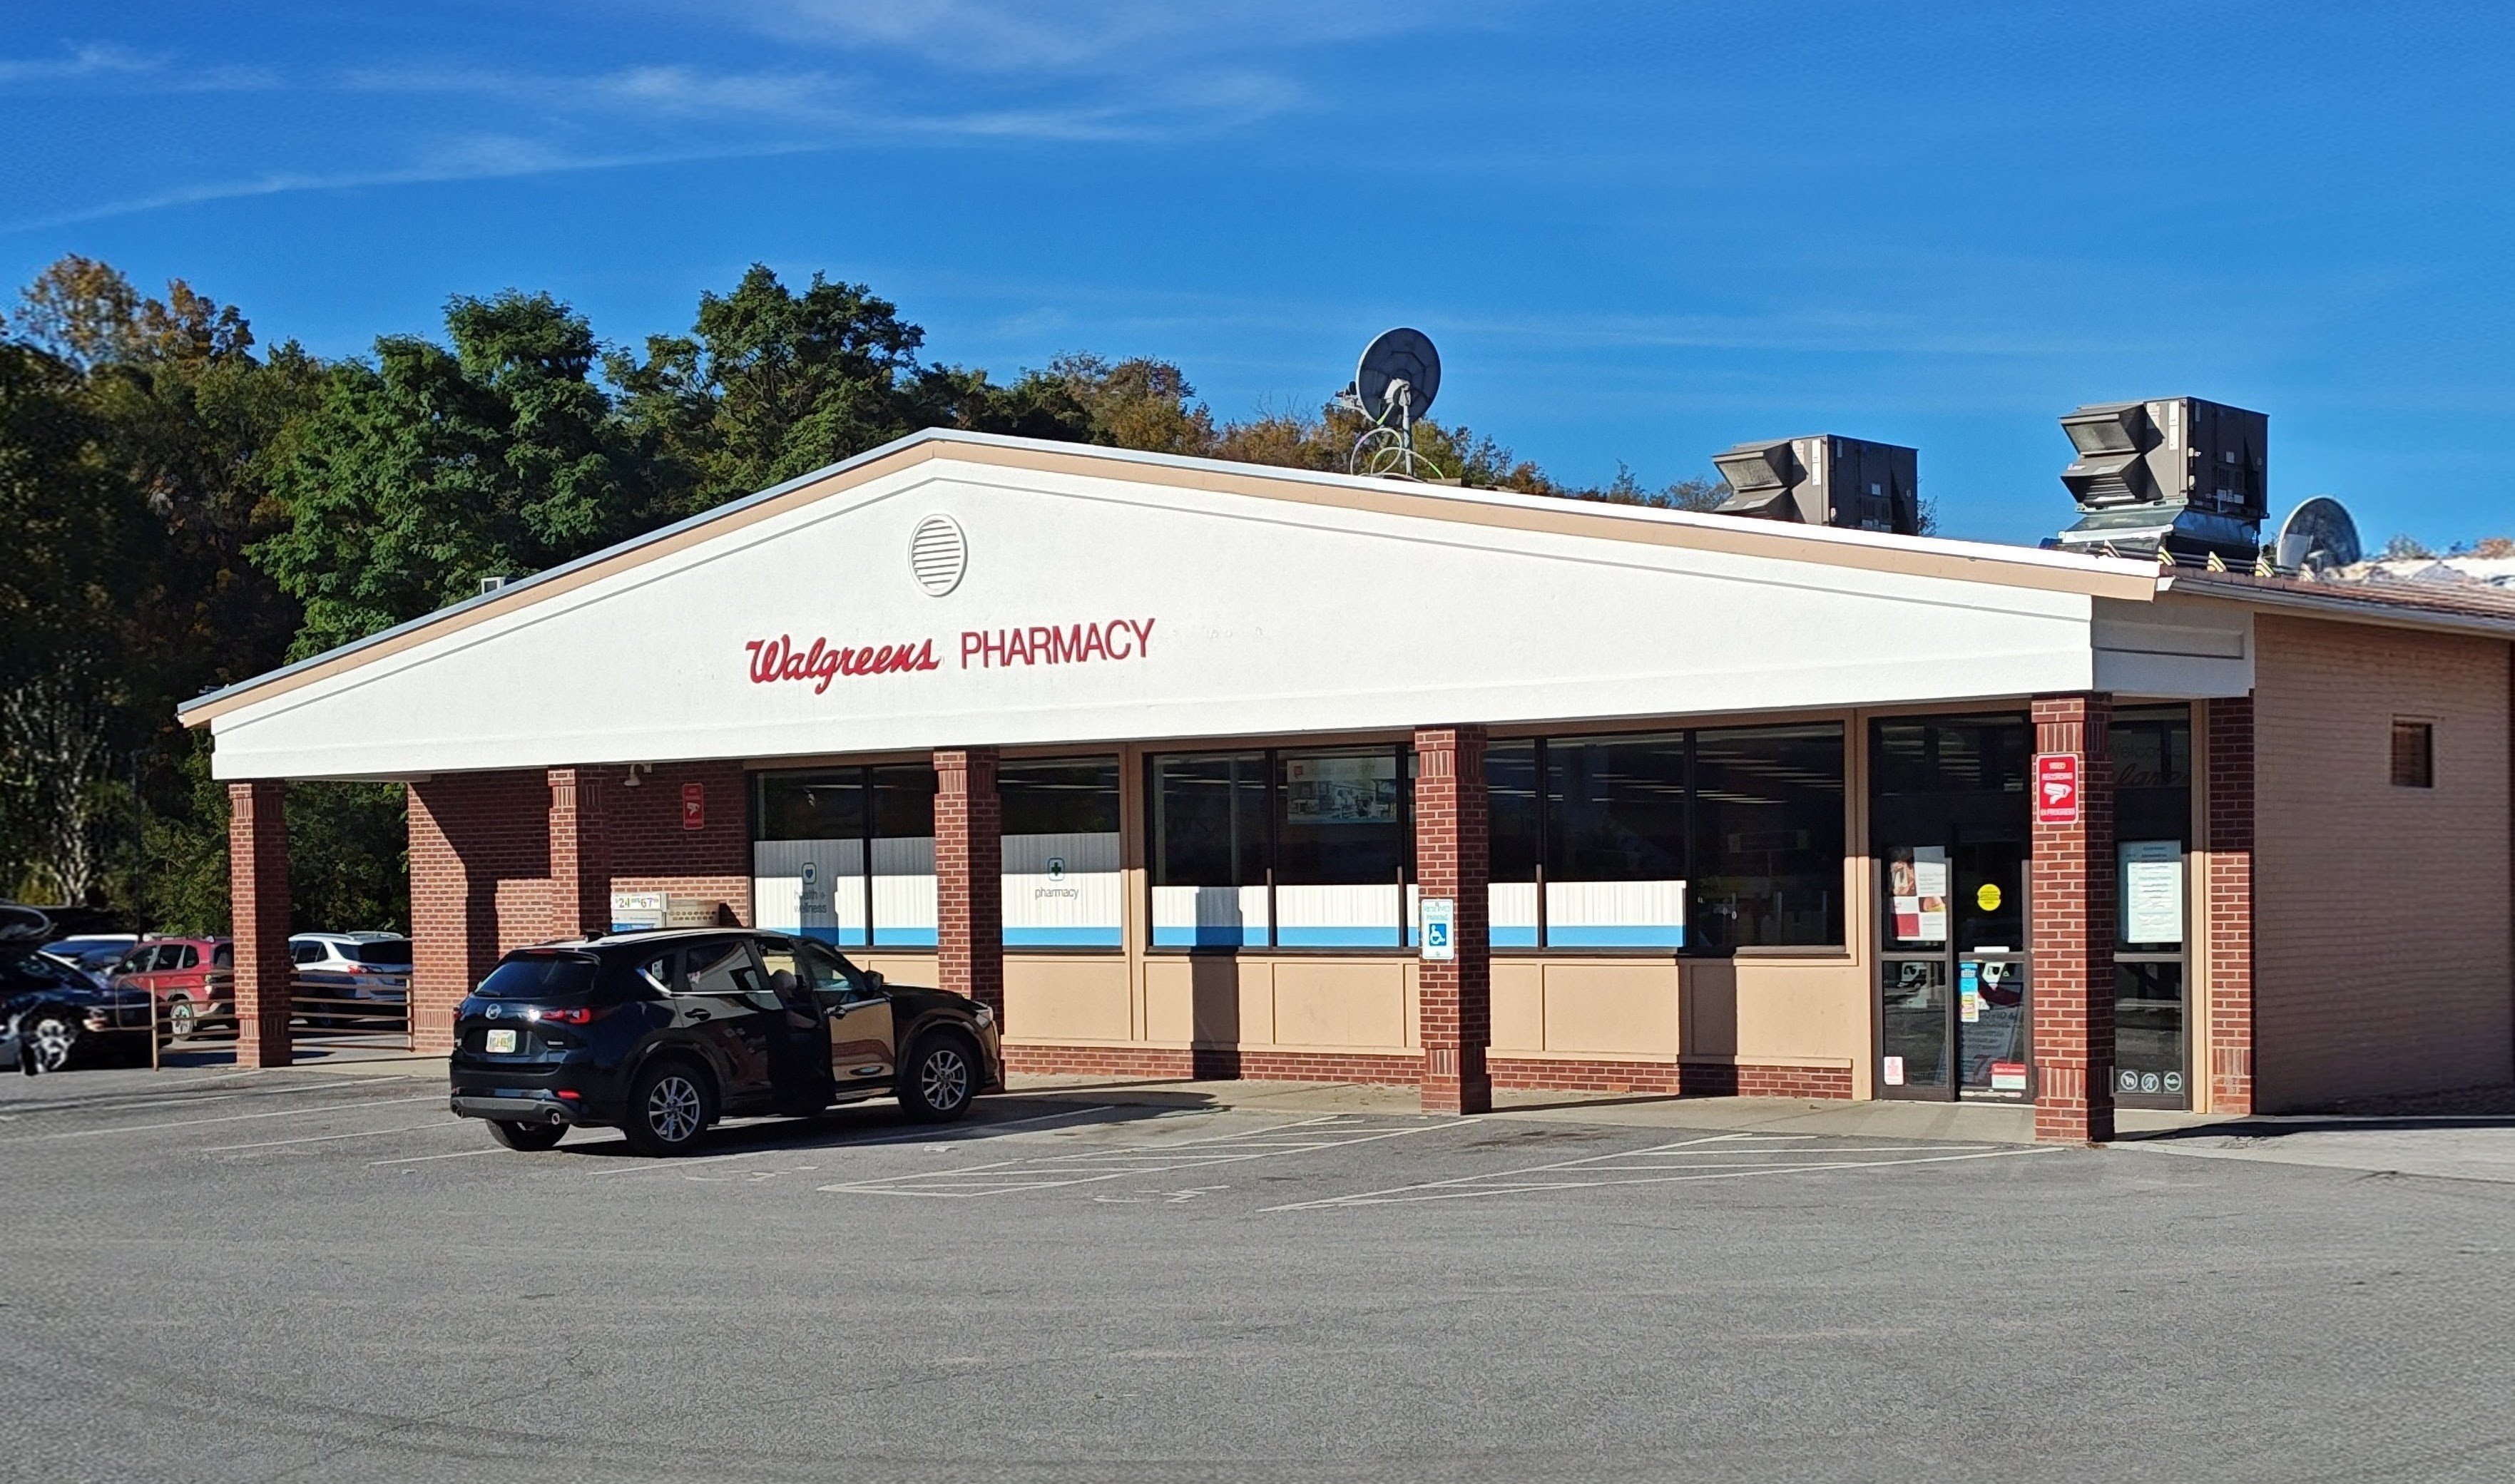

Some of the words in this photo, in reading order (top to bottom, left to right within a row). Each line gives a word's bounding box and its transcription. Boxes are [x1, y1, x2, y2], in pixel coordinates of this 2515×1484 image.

[745, 634, 939, 695] Walgreens
[961, 618, 1156, 669] PHARMACY
[1035, 886, 1079, 901] pharmacy
